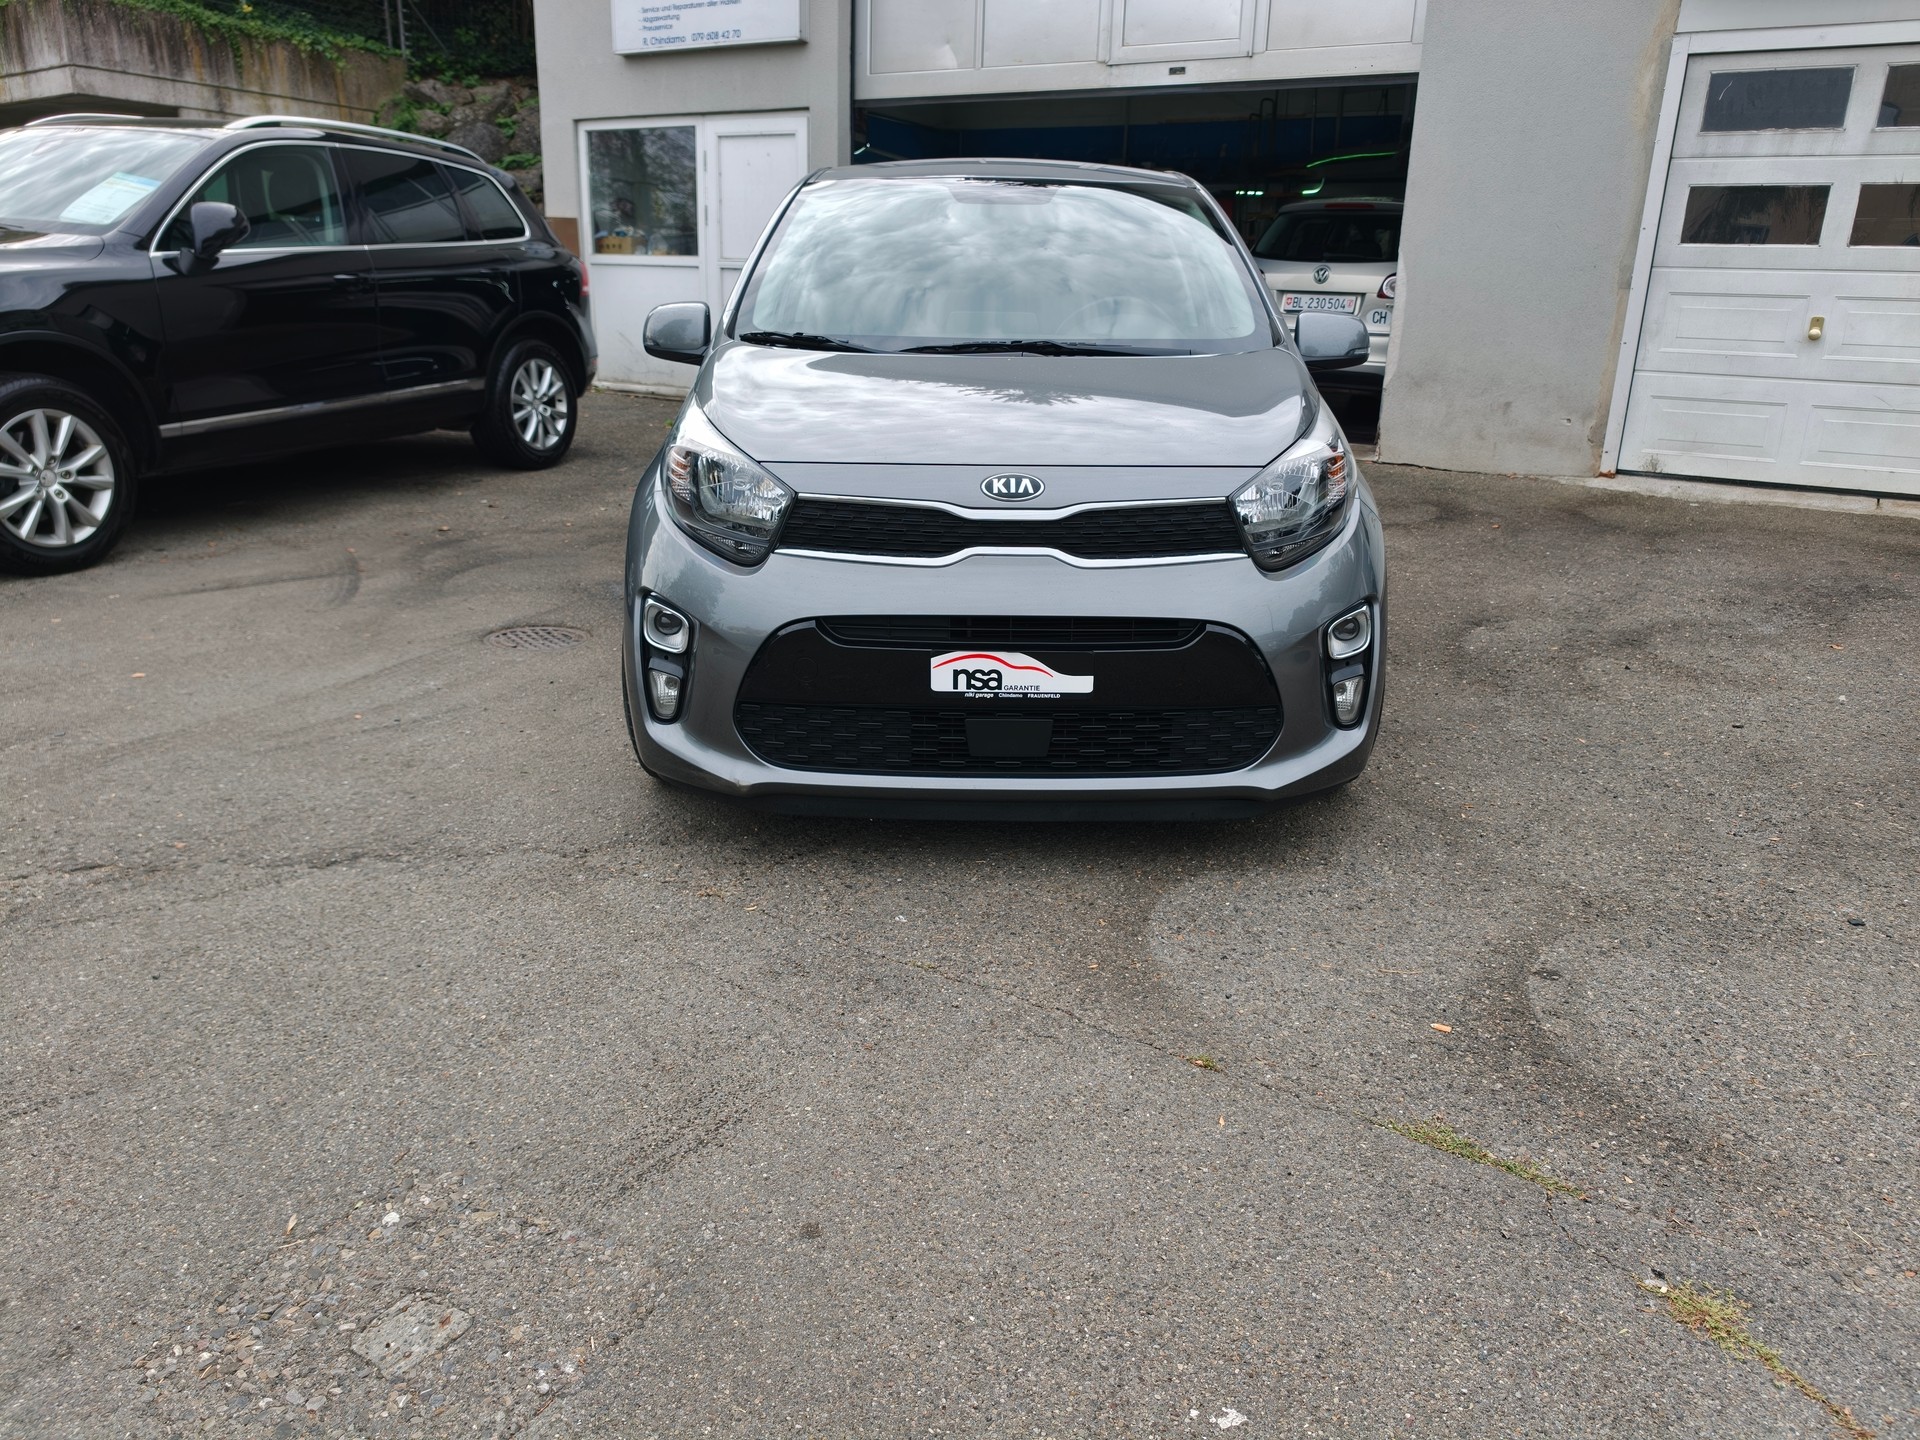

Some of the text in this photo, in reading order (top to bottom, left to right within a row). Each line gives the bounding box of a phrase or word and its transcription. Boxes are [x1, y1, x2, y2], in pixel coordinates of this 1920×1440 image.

[650, 36, 686, 46] Chindamo
[691, 32, 705, 42] 079
[1372, 311, 1387, 324] CH
[992, 478, 1034, 494] KIA
[953, 669, 1002, 691] nsa
